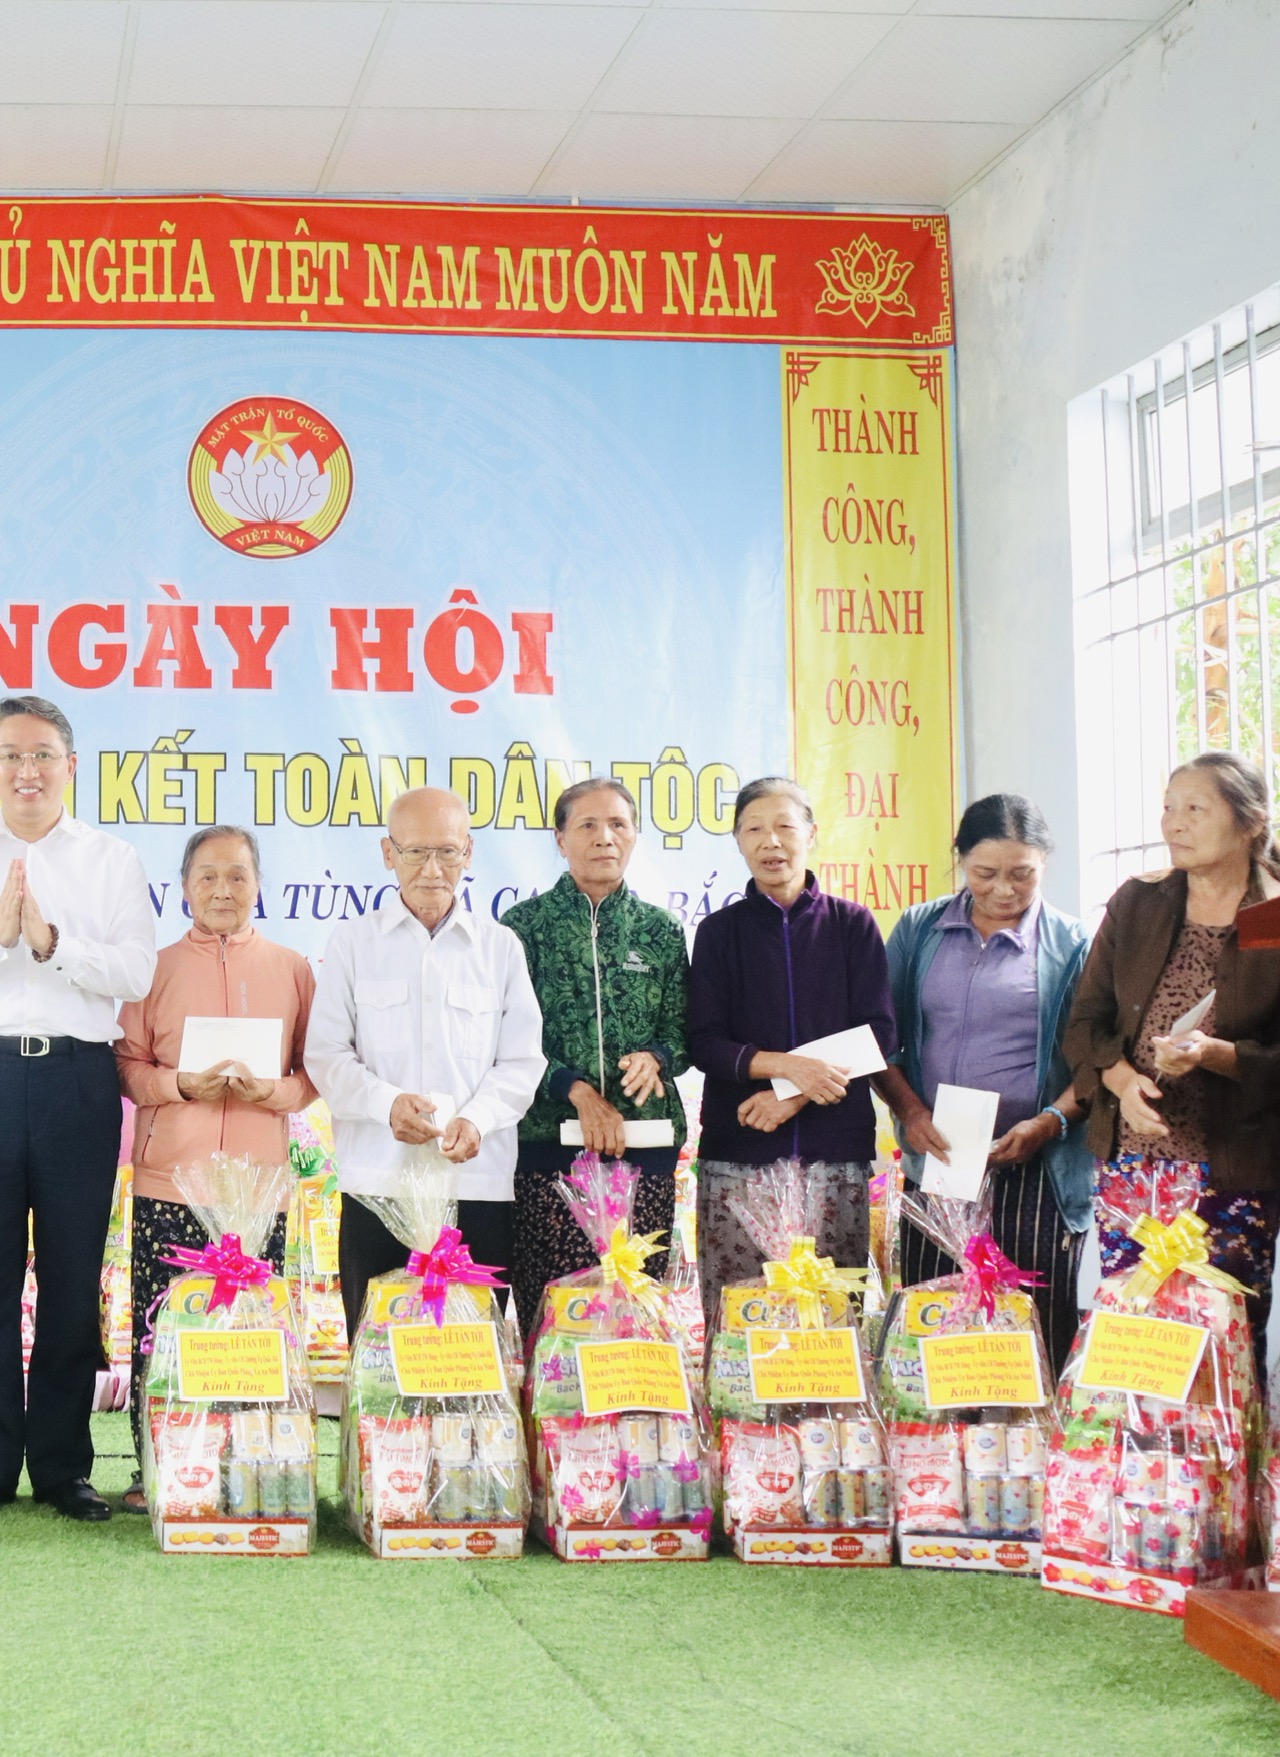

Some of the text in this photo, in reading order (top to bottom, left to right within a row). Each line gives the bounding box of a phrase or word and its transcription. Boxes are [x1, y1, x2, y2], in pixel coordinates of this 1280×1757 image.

[47, 220, 214, 304] NGHĨA
[230, 217, 350, 323] VIỆT
[363, 243, 481, 310] NAM
[495, 224, 646, 315] MUÔN
[661, 232, 777, 318] NĂM
[207, 407, 329, 448] MẶT TRẬN TỔ QUỐC
[812, 393, 919, 456] THÀNH
[235, 528, 305, 548] VIỆT NAM
[821, 481, 917, 555] CÔNG,
[815, 573, 925, 636] THÀNH
[329, 588, 554, 714] HỘI
[824, 664, 920, 736] CÔNG,
[99, 728, 227, 826] KẾT
[611, 745, 741, 851] TỘC
[844, 772, 900, 832] ĐẠI
[819, 848, 929, 910] THÀNH
[776, 1382, 840, 1395] Kính Tặng
[249, 1534, 278, 1542] MAJESTIC
[466, 1538, 496, 1546] MAJESTIC
[832, 1544, 862, 1552] MAJESTIC
[995, 1551, 1027, 1560] MAJESTIC
